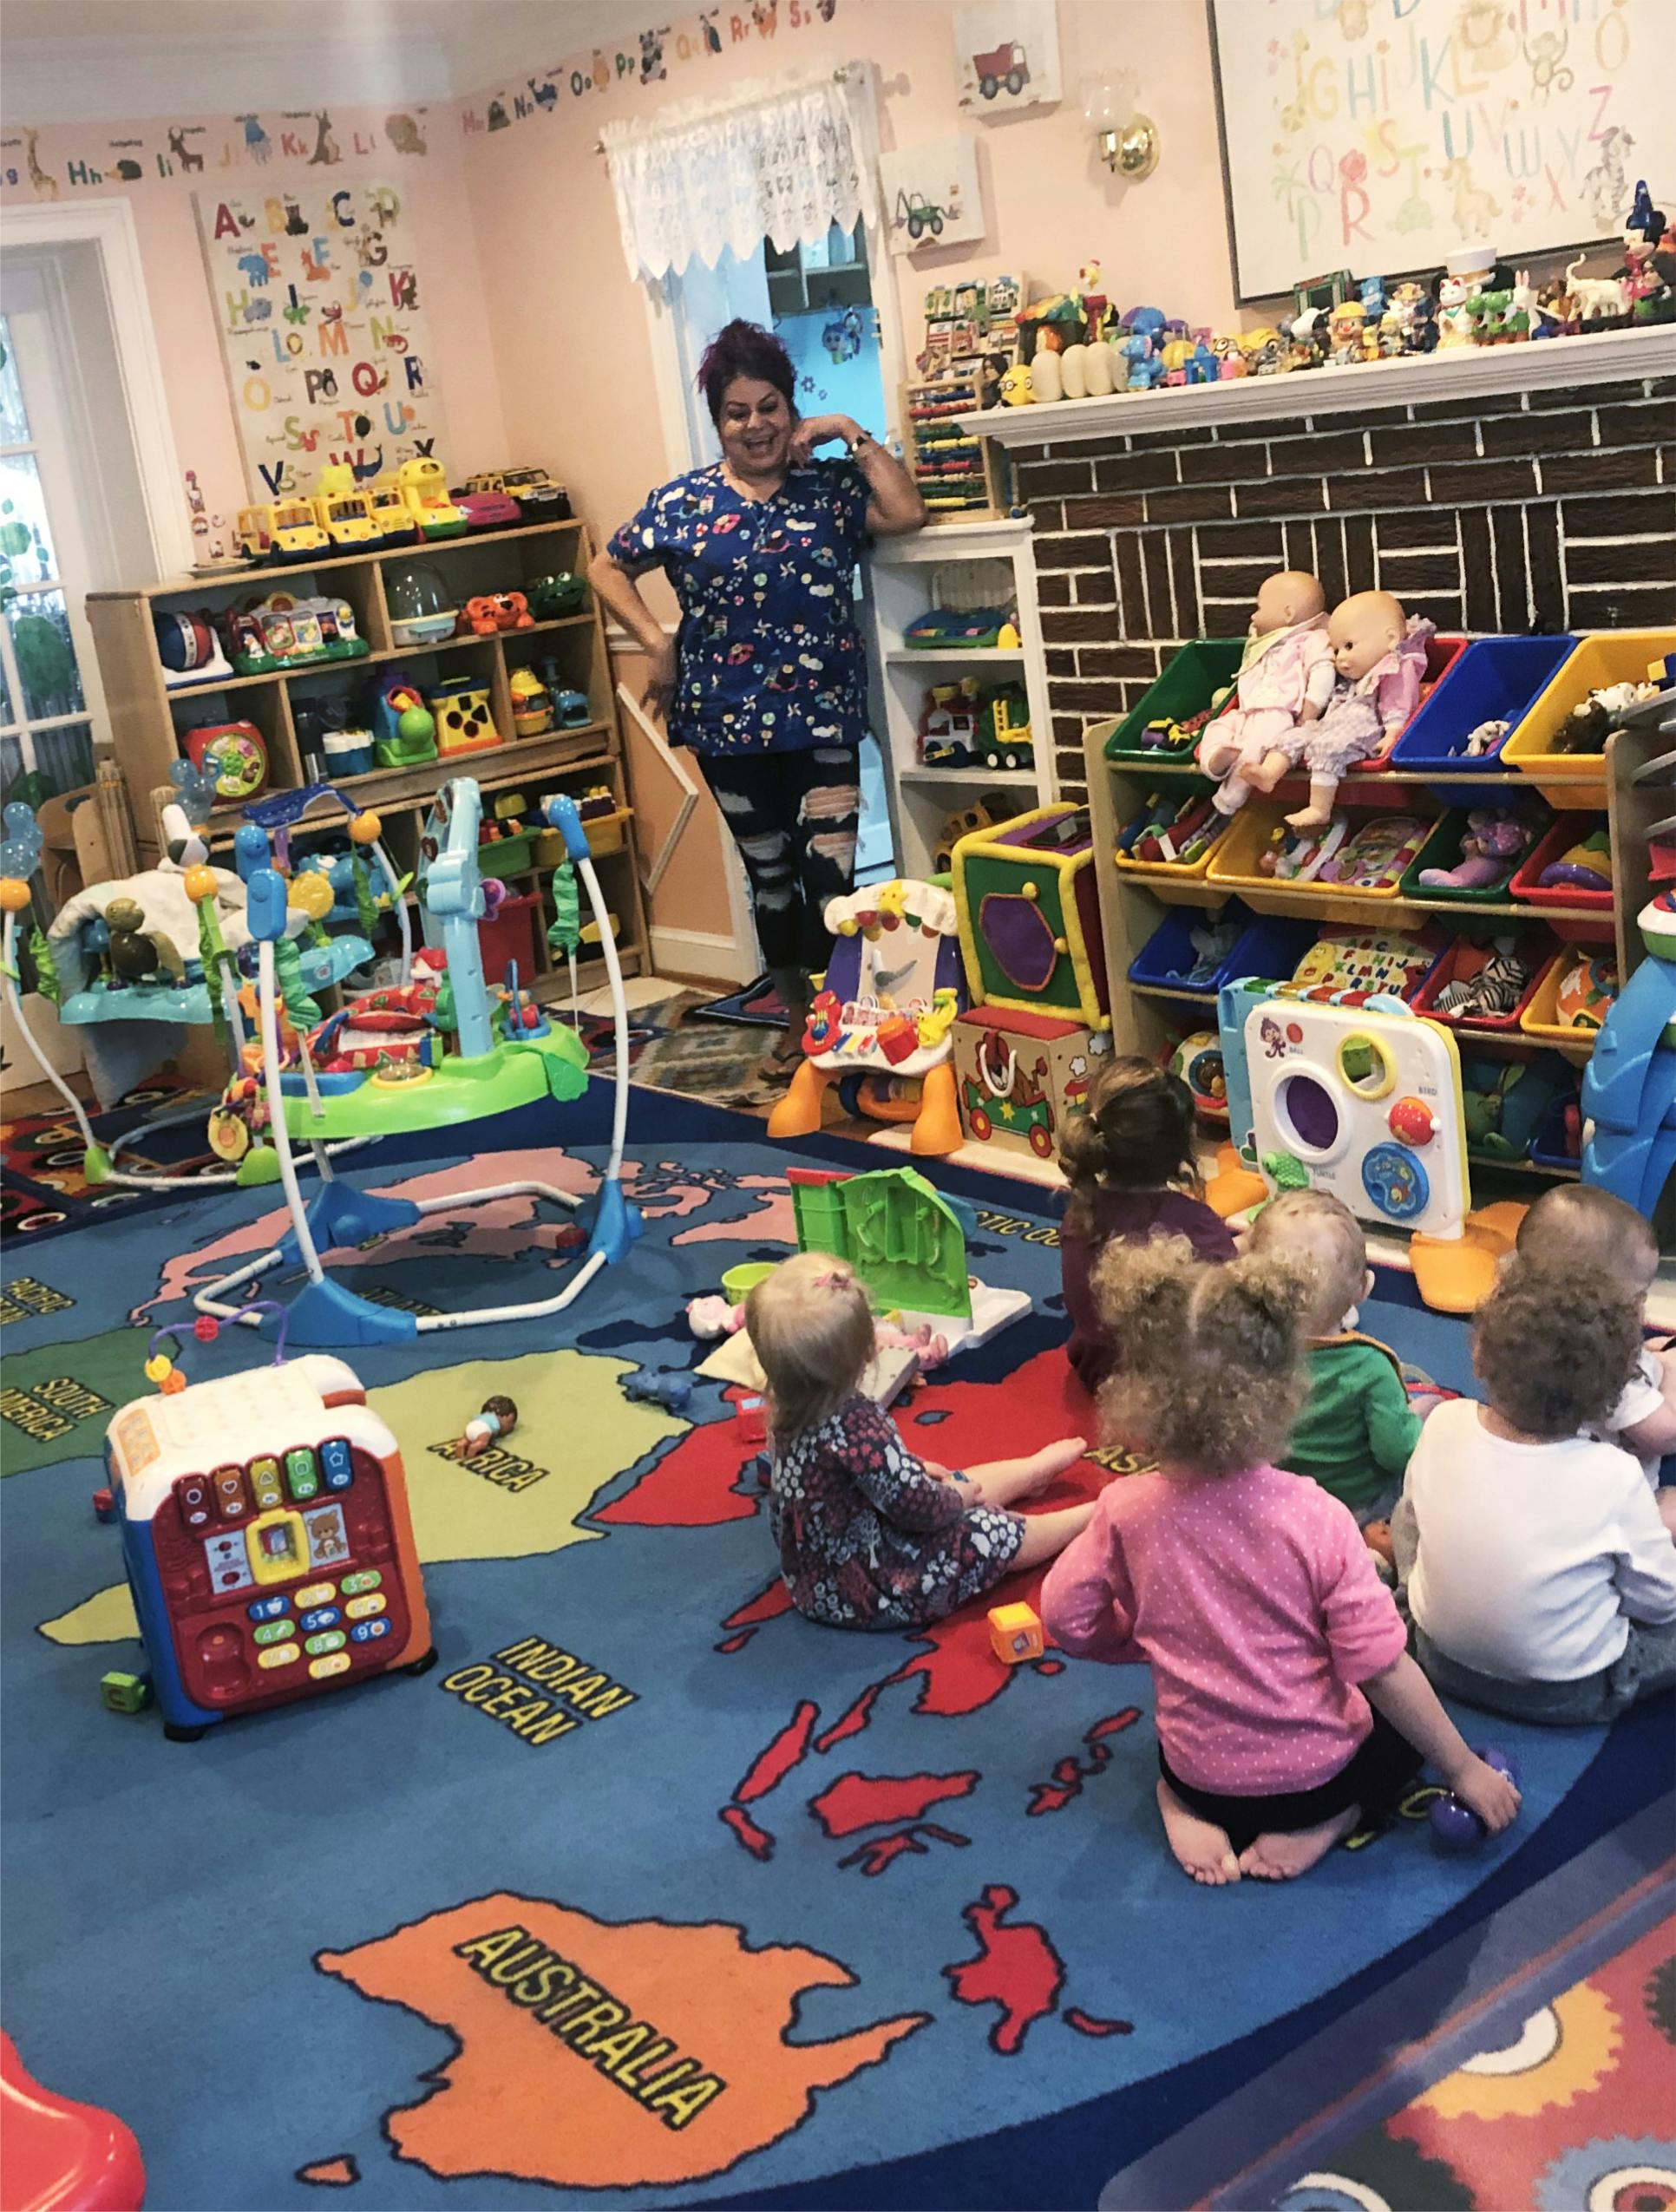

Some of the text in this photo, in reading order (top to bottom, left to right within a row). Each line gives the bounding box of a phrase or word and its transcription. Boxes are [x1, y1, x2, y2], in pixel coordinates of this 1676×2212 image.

[571, 70, 592, 96] Oo
[615, 52, 635, 79] Pp
[1420, 33, 1456, 110] K
[67, 160, 103, 186] Hh
[1340, 183, 1376, 245] R
[1588, 85, 1612, 141] Z
[214, 203, 240, 239] A
[265, 198, 287, 233] B
[332, 191, 355, 226] C
[312, 237, 331, 265] F
[226, 289, 249, 325] H
[389, 271, 409, 306] K
[318, 321, 349, 357] M
[370, 316, 394, 350] N
[243, 356, 423, 412] O P Q R
[285, 401, 407, 450] S T U
[258, 461, 284, 496] V
[1347, 964, 1356, 975] L
[1375, 967, 1390, 979] N
[1396, 959, 1409, 969] J
[1388, 984, 1401, 995] U
[31, 1377, 114, 1420] SOUTH
[428, 1437, 547, 1492] ARICA
[256, 1604, 264, 1619] 1
[348, 1578, 357, 1593] 3
[262, 1628, 272, 1640] 4
[306, 1616, 318, 1630] 5
[313, 1640, 324, 1654] 8
[357, 1626, 369, 1640] 9
[491, 1635, 639, 1720] INDIAN
[440, 1663, 582, 1746] OCEAN
[454, 1926, 726, 2130] AUSTRALIA
